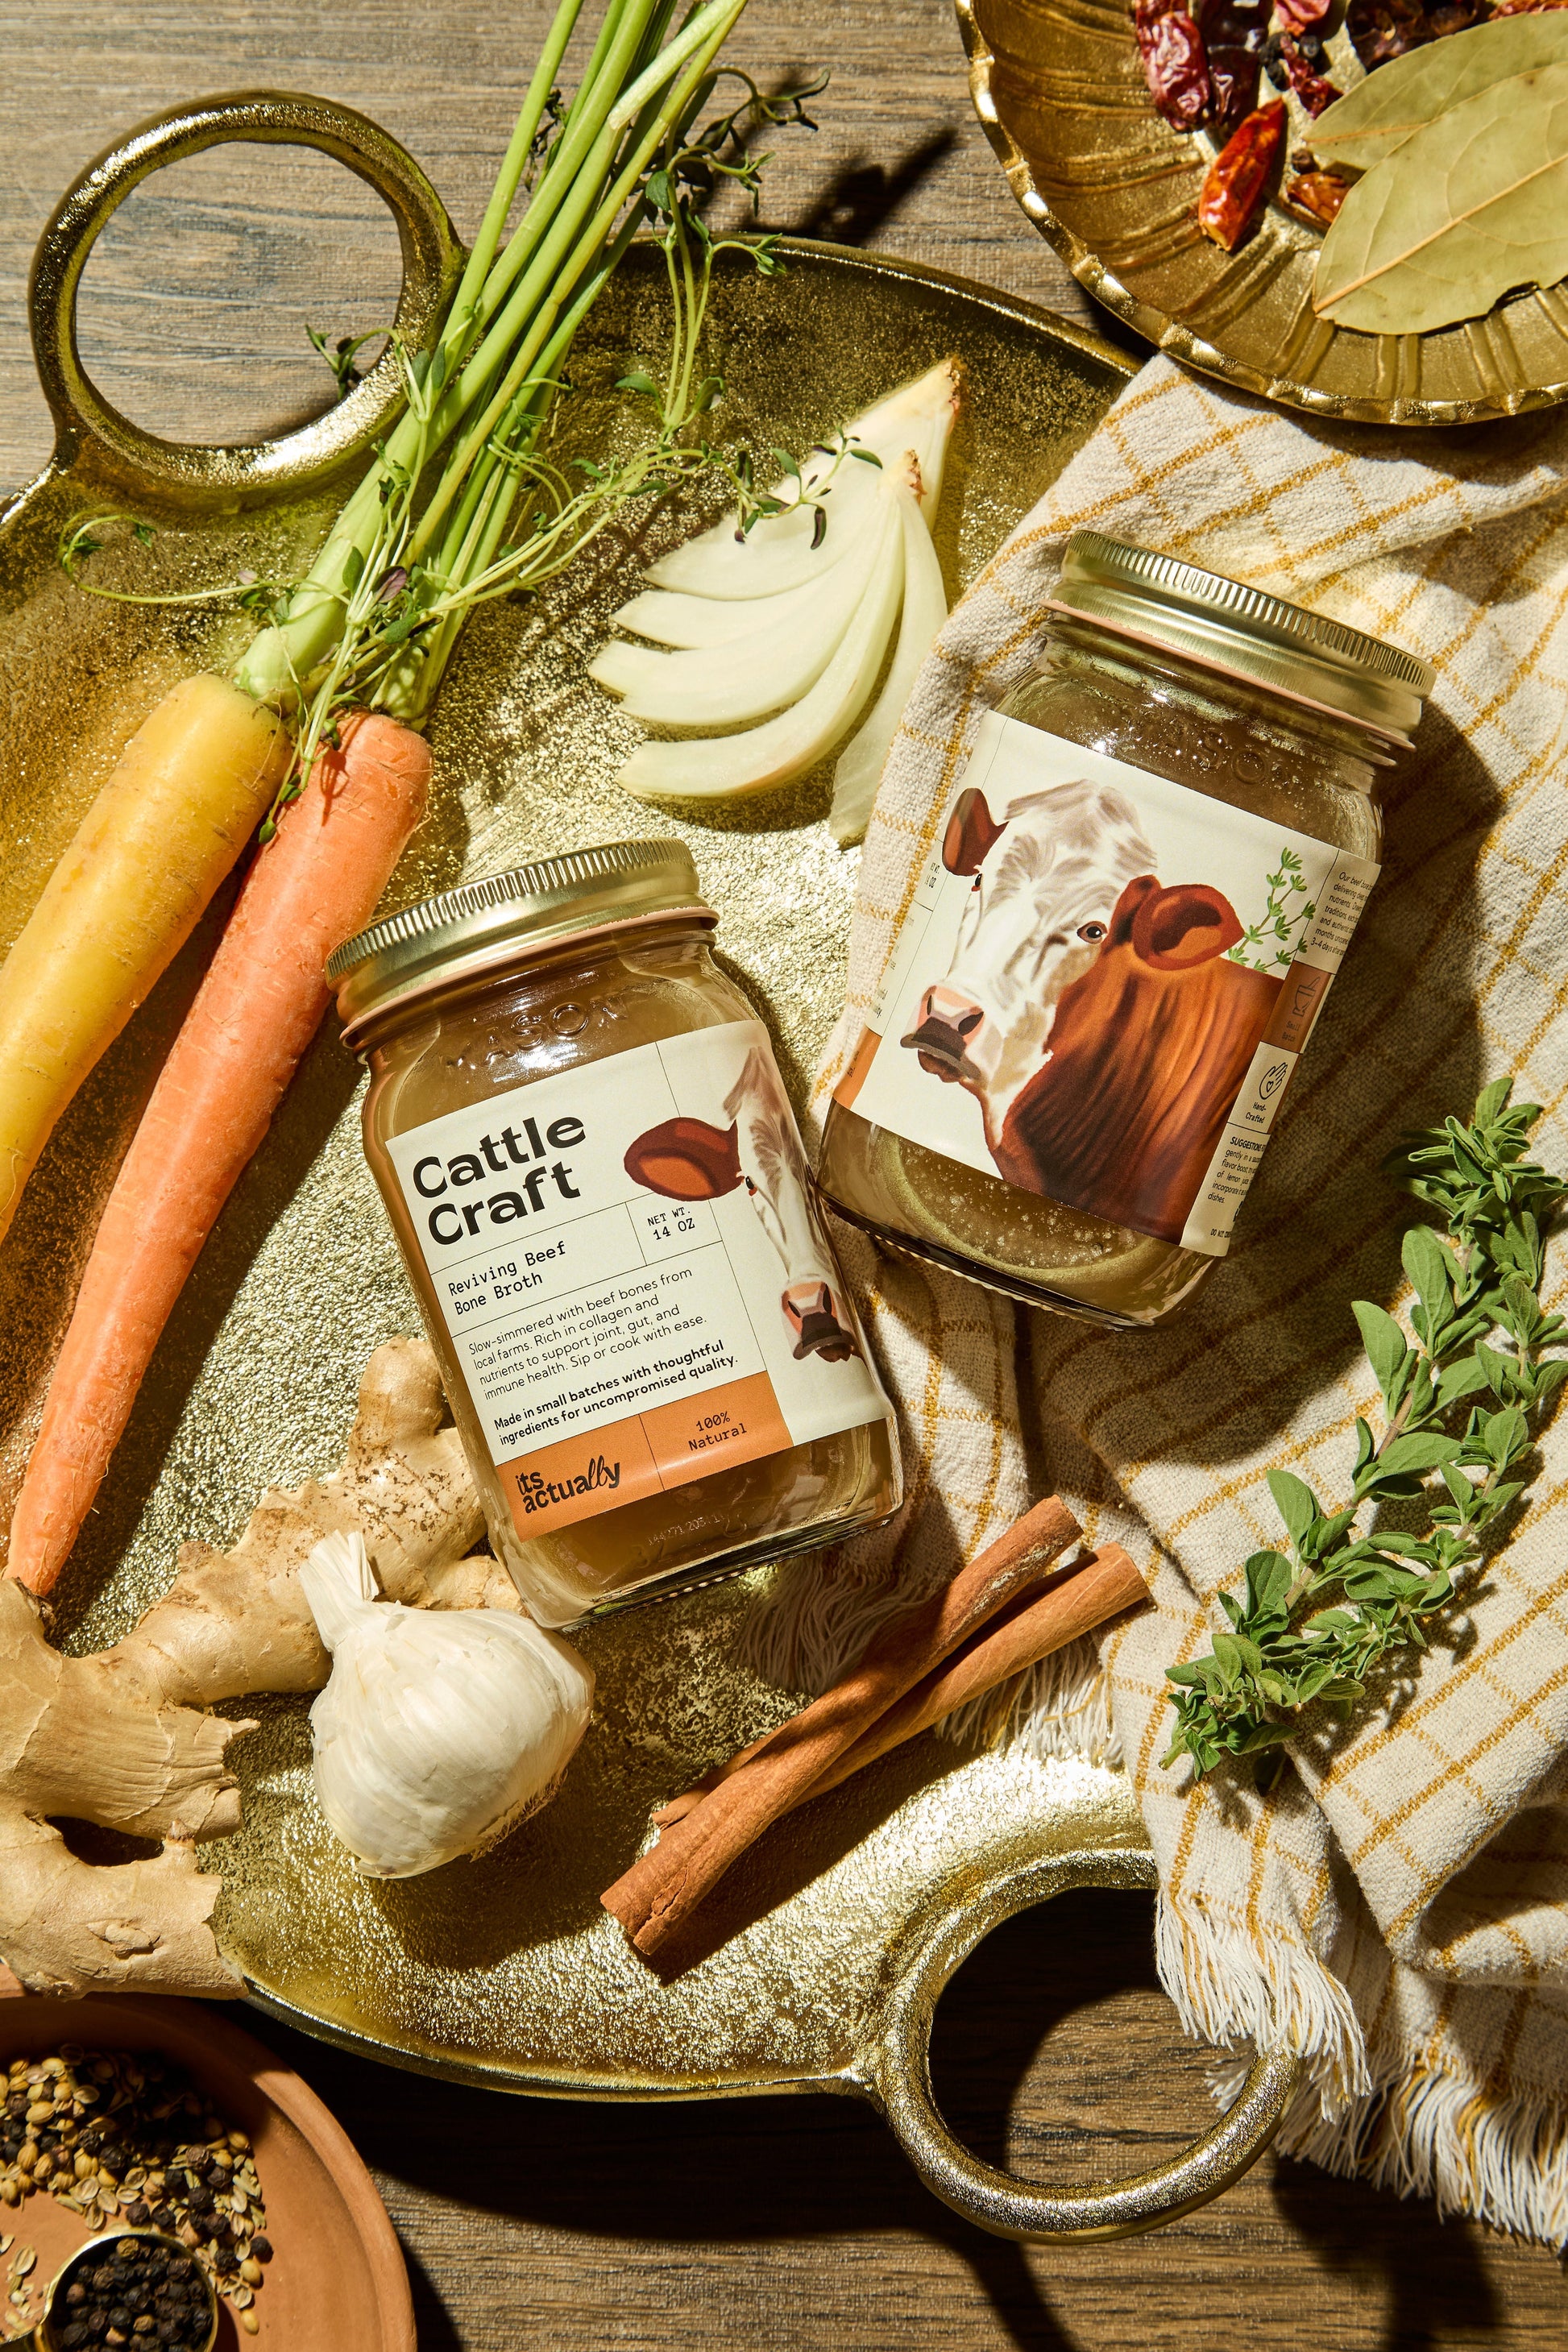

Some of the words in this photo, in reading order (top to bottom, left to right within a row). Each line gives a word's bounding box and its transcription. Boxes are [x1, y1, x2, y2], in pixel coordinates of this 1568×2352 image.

[1339, 871, 1351, 881] Our
[1320, 917, 1331, 926] and
[1315, 927, 1334, 941] months
[1321, 941, 1332, 954] days
[1245, 1111, 1265, 1124] Crafted
[1253, 1101, 1267, 1111] Hand-
[413, 1117, 587, 1198] Cattle
[1221, 1159, 1237, 1171] flavor
[1225, 1149, 1243, 1162] gently
[1217, 1170, 1225, 1178] of
[1226, 1172, 1241, 1184] lemon
[428, 1161, 581, 1245] Craft
[647, 1213, 667, 1226] NET
[671, 1206, 691, 1218] WT.
[653, 1226, 671, 1241] 14
[678, 1217, 695, 1232] OZ
[448, 1262, 517, 1296] Reviving
[525, 1240, 566, 1267] Beef
[454, 1294, 487, 1315] Bone
[493, 1272, 543, 1300] Broth
[468, 1313, 554, 1355] Slow-simmered
[557, 1304, 584, 1321] with
[586, 1291, 616, 1311] beef
[618, 1280, 658, 1300] bones
[660, 1269, 693, 1286] from
[473, 1351, 497, 1371] local
[497, 1342, 533, 1361] farms.
[533, 1329, 562, 1346] Rich
[563, 1325, 577, 1336] in
[579, 1305, 633, 1330] collagen
[635, 1293, 660, 1312] and
[479, 1360, 525, 1385] nutrients
[526, 1356, 540, 1367] to
[541, 1336, 591, 1362] support
[592, 1325, 625, 1346] joint,
[627, 1316, 653, 1334] gut,
[655, 1304, 681, 1321] and
[483, 1378, 525, 1400] immune
[526, 1362, 568, 1383] health.
[570, 1354, 591, 1367] Sip
[593, 1348, 606, 1360] or
[610, 1335, 641, 1354] cook
[643, 1325, 672, 1342] with
[674, 1316, 707, 1332] ease.
[494, 1412, 523, 1430] Made
[522, 1408, 535, 1419] in
[536, 1393, 567, 1415] small
[568, 1378, 620, 1402] batches
[622, 1366, 652, 1383] with
[653, 1339, 724, 1373] thoughtful
[499, 1416, 560, 1446] ingredients
[561, 1408, 580, 1422] for
[583, 1369, 687, 1415] uncompromised
[689, 1355, 738, 1379] quality.
[695, 1411, 731, 1432] 100%
[687, 1422, 748, 1451] Natural
[514, 1471, 545, 1495] its
[522, 1454, 621, 1514] actually
